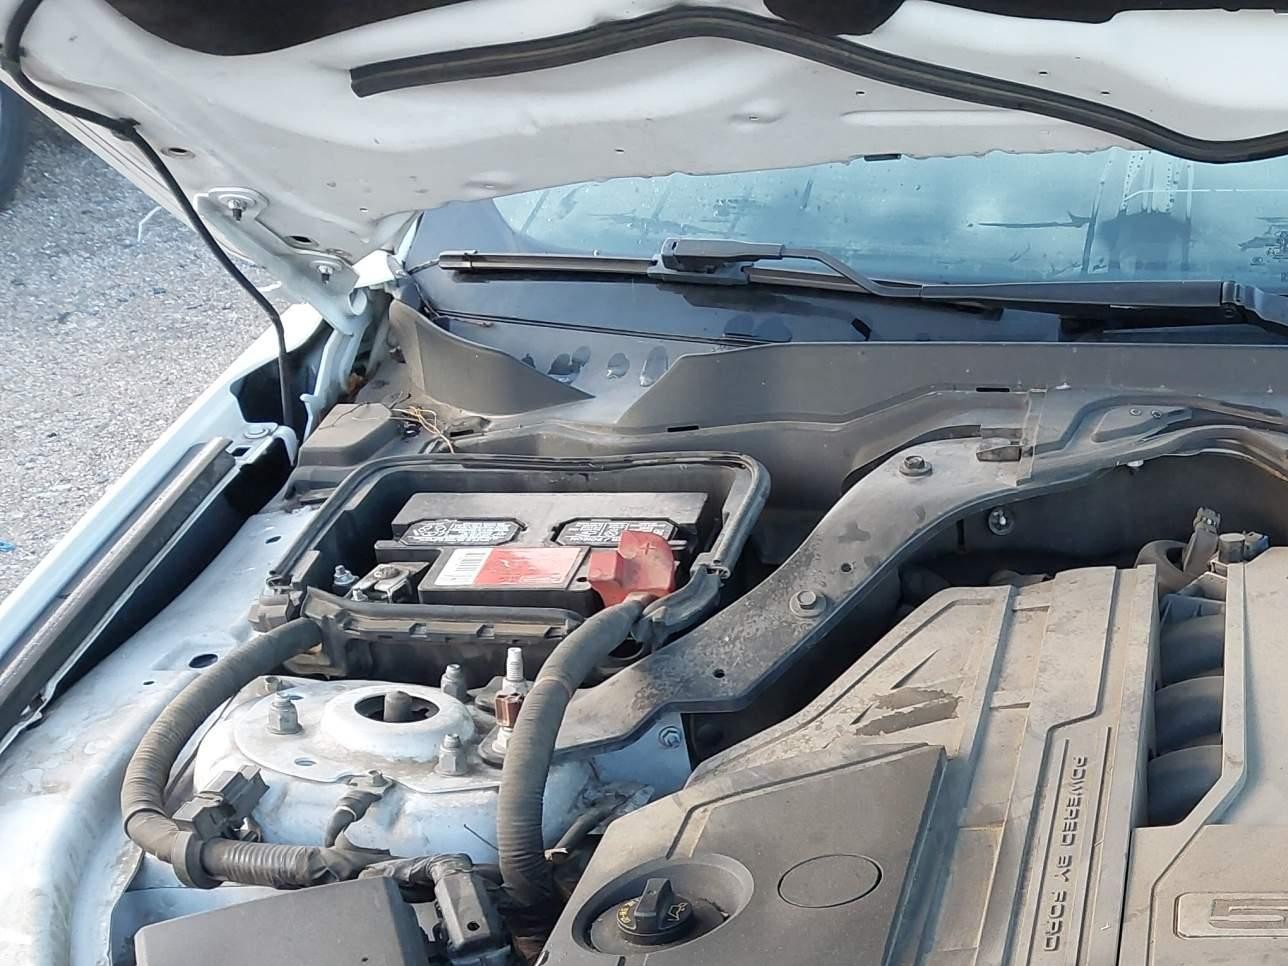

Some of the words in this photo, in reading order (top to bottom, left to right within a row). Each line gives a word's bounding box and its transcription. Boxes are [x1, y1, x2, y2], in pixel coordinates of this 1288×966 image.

[1059, 756, 1088, 847] POWERED
[1054, 854, 1073, 883] BY
[1043, 890, 1068, 951] FORD
